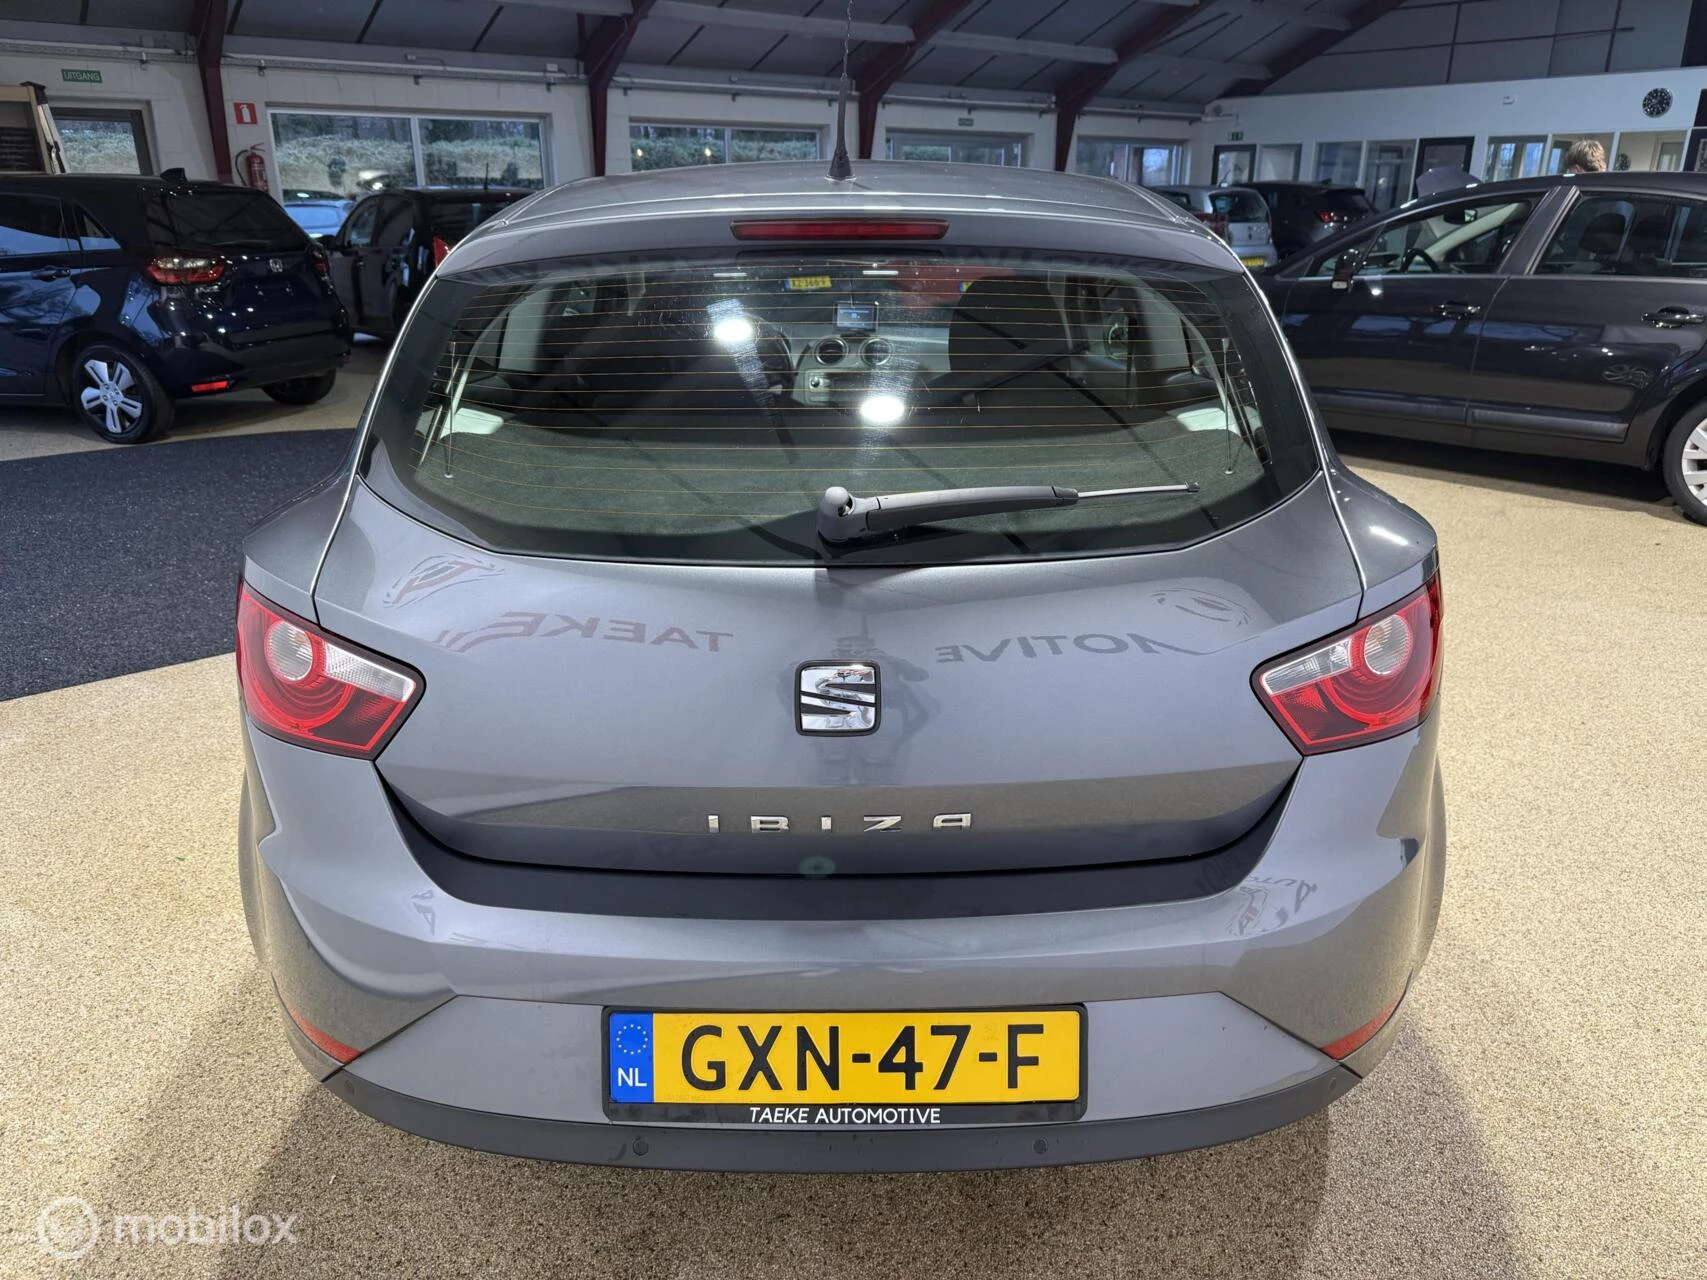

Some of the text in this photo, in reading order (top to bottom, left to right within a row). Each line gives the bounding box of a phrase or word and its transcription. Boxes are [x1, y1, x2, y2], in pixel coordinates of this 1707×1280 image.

[63, 71, 101, 81] UITGANG
[708, 813, 972, 833] IBIZA
[681, 1023, 1044, 1091] GXN-47-F
[617, 1067, 647, 1087] NL
[750, 1107, 941, 1124] TAEKE AUTOMOTIVE
